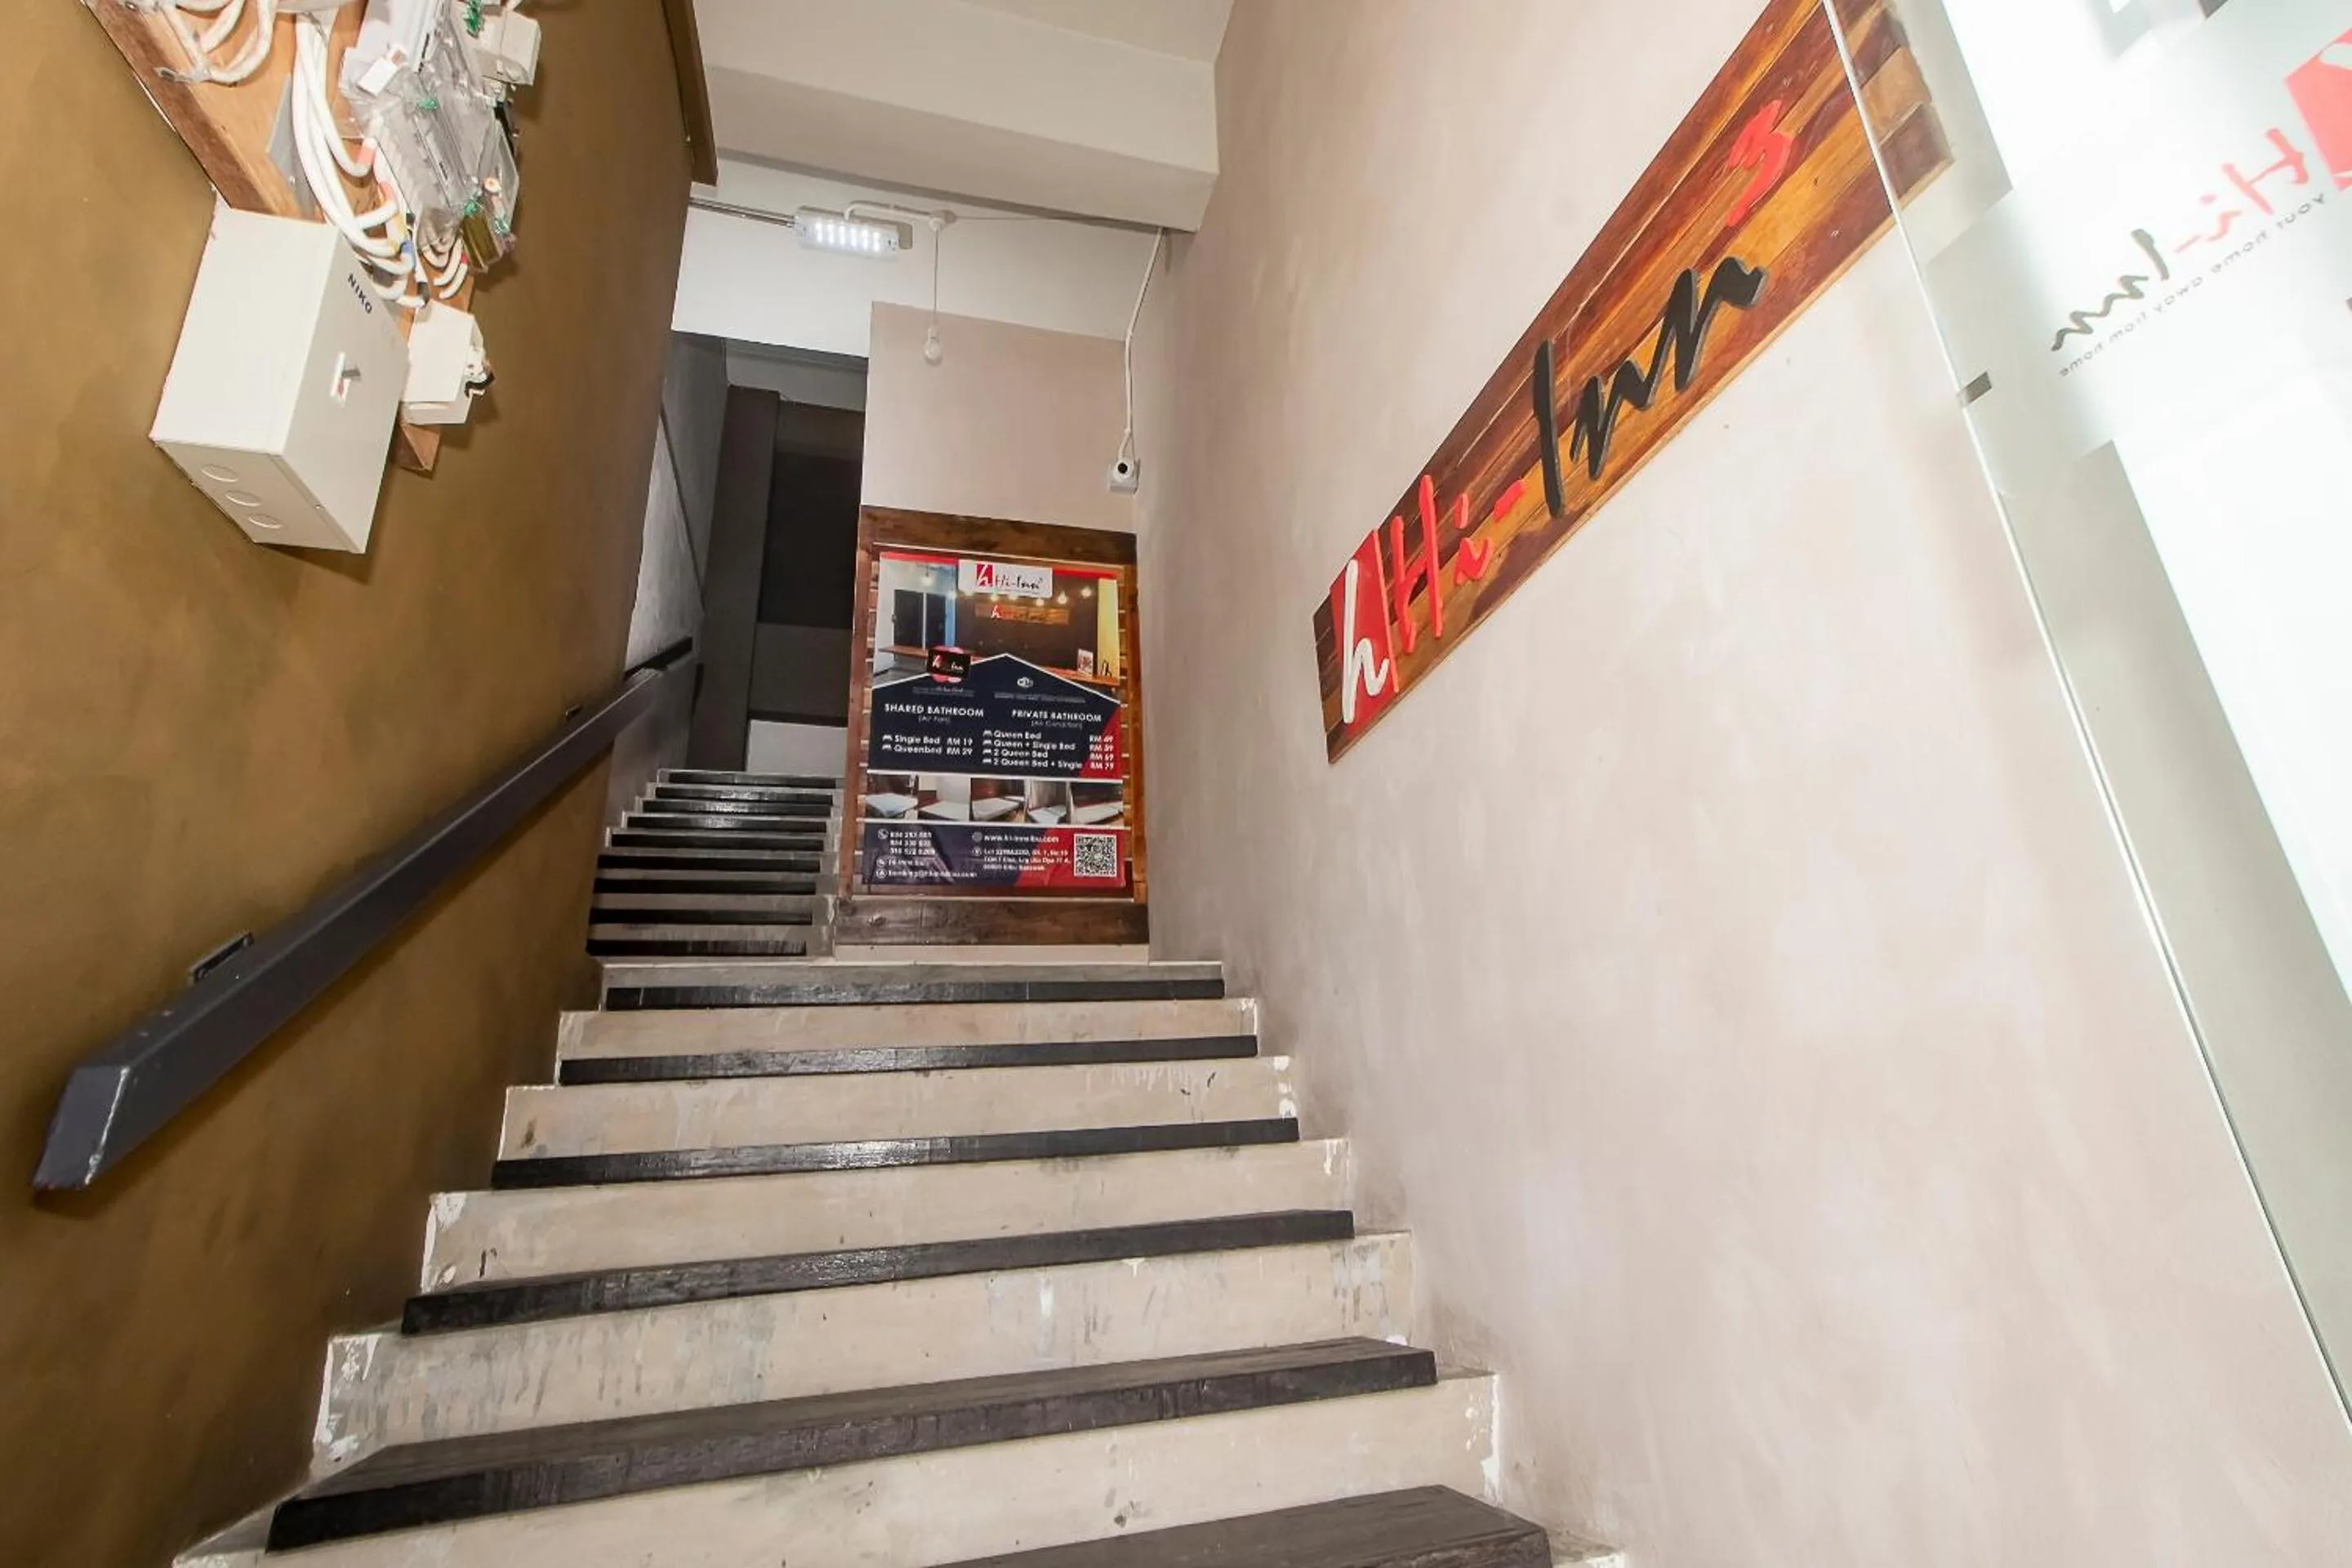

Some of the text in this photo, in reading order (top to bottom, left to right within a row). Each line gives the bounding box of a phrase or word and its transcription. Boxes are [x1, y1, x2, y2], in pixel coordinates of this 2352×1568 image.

[347, 273, 373, 314] NIKO
[884, 703, 984, 718] SHARED BATHROOM
[1011, 709, 1102, 723] PRIVATE BATHROOM
[894, 735, 921, 745] Single
[923, 736, 941, 745] Bed
[947, 737, 960, 746] RM
[993, 730, 1023, 739] Queen
[1025, 732, 1042, 740] Bed
[947, 746, 960, 755] RM
[993, 739, 1023, 748] Queen
[1032, 742, 1058, 751] Single
[1059, 743, 1076, 751] Bed
[1000, 749, 1030, 757] Queen
[1031, 751, 1049, 759] Bed
[1089, 753, 1103, 761] RM
[1000, 758, 1030, 767] Queen
[1031, 760, 1049, 768] Bed
[1090, 762, 1104, 770] RM
